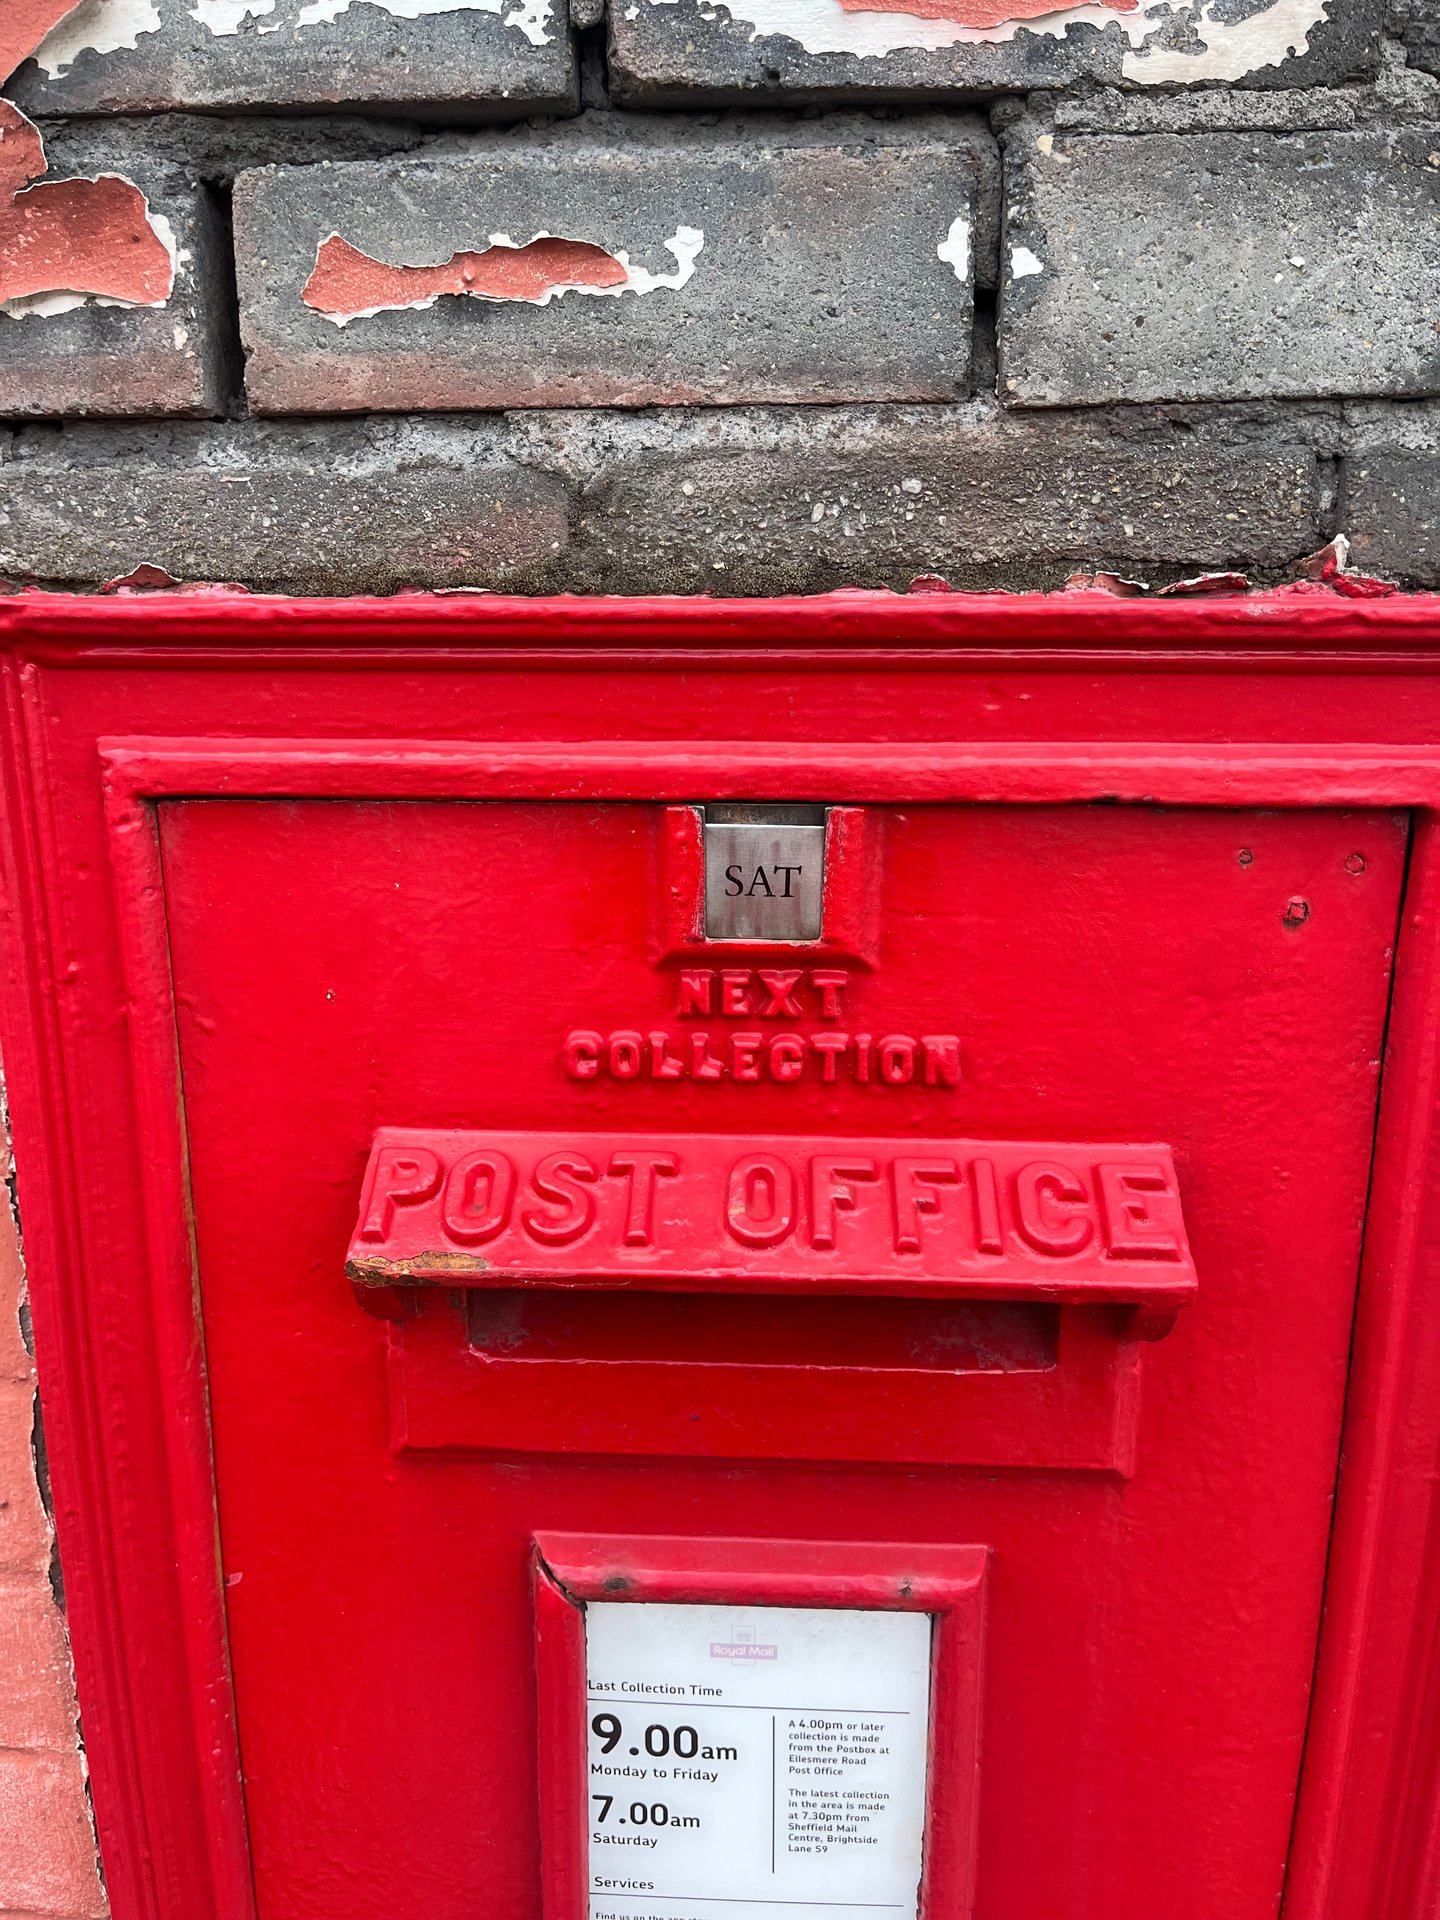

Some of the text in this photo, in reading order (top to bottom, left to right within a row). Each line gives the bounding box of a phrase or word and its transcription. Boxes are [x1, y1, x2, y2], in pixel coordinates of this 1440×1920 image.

[725, 865, 802, 897] SAT
[679, 968, 848, 1020] NEXT
[563, 1030, 962, 1086] COLLECTION
[359, 1146, 1181, 1261] POST OFFICE
[713, 1645, 774, 1657] Royal Mail
[588, 1679, 723, 1697] Last Collection Time
[788, 1719, 796, 1728] A
[798, 1719, 843, 1731] 4.00pm
[860, 1722, 885, 1731] later
[591, 1712, 738, 1761] 9.00am
[788, 1732, 880, 1743] collection is made
[788, 1743, 890, 1755] from the Postbox at
[788, 1754, 867, 1765] Ellesmere Road
[591, 1763, 719, 1783] Monday to Friday
[788, 1765, 844, 1776] Post Office
[788, 1788, 890, 1800] The latest collection
[592, 1794, 700, 1828] 7.00am
[788, 1800, 798, 1808] in
[801, 1800, 818, 1809] the
[846, 1801, 855, 1810] is
[858, 1803, 886, 1811] made
[788, 1811, 870, 1822] at 7.30pm from
[788, 1822, 858, 1833] Sheffield Mail
[593, 1832, 658, 1849] Saturday
[788, 1833, 879, 1845] Centre, Brightside
[788, 1844, 829, 1854] Lane S9
[594, 1876, 655, 1890] Services
